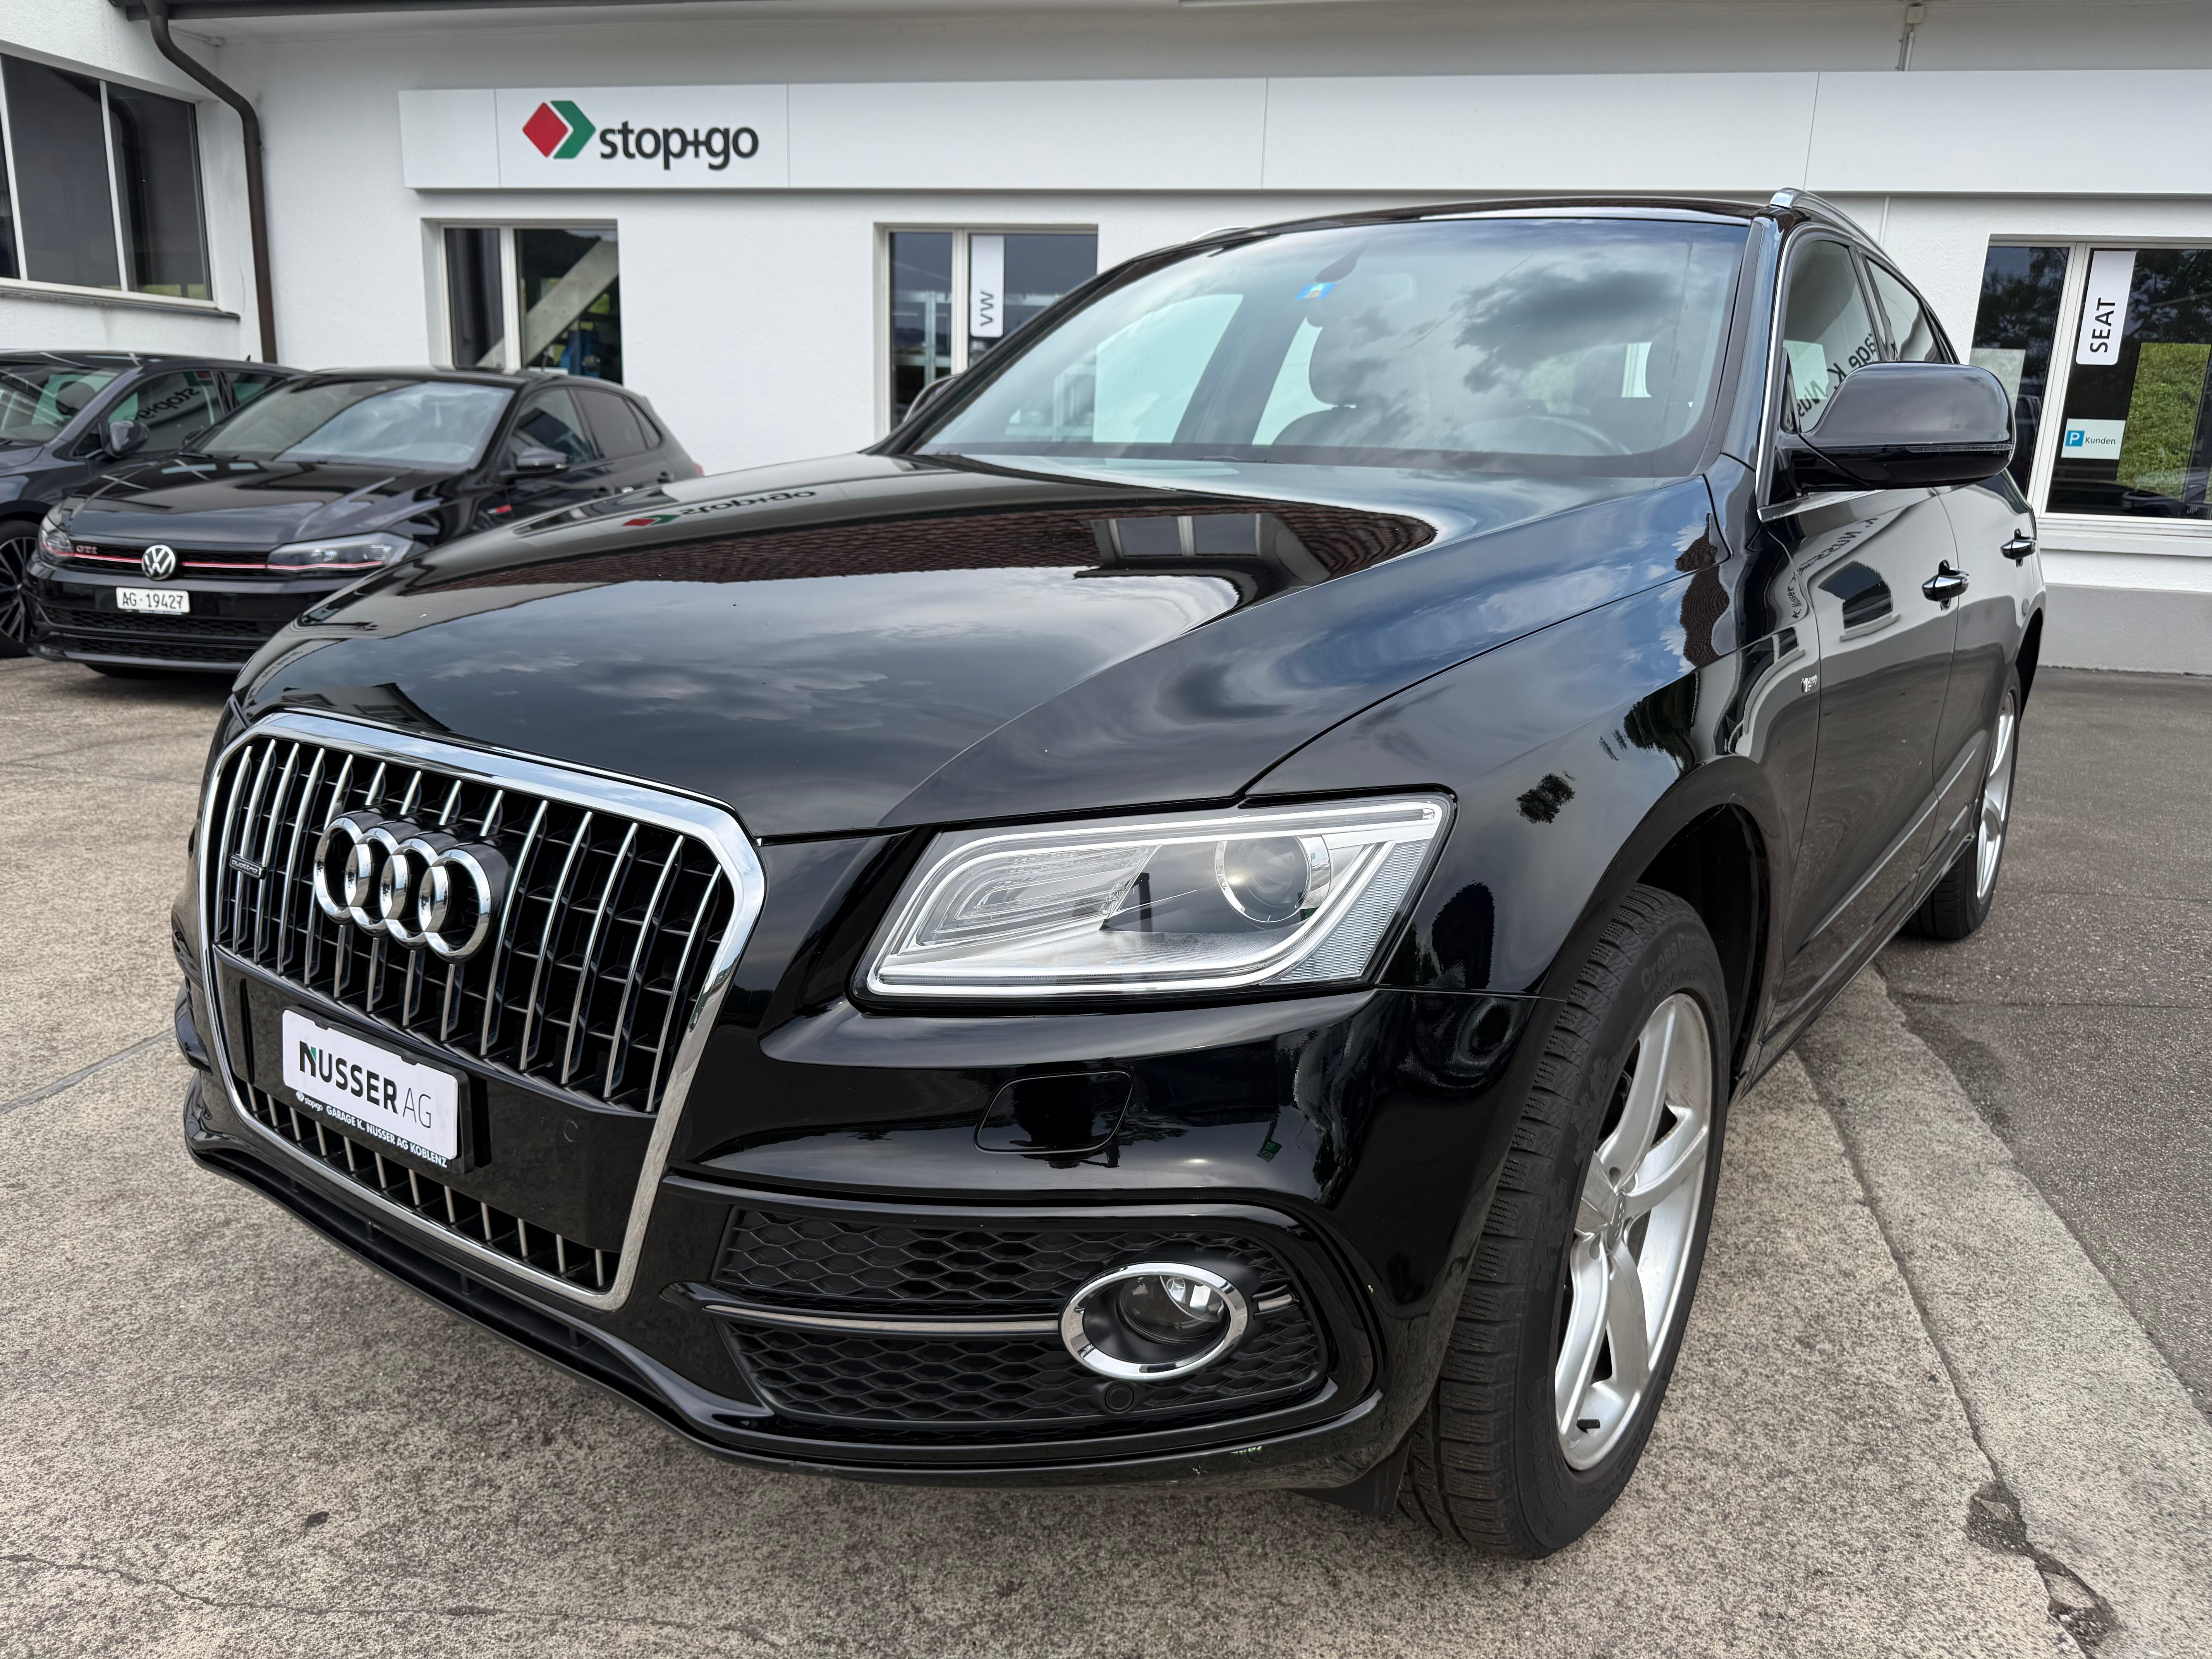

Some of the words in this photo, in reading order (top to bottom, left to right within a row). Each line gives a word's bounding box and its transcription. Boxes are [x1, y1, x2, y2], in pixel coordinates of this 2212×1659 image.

[599, 120, 758, 170] stop+go
[980, 290, 993, 327] VW
[2090, 297, 2115, 353] SEAT
[2069, 432, 2080, 445] P
[2085, 436, 2116, 445] Kunden
[76, 545, 98, 554] GTI
[122, 592, 137, 606] AG
[146, 593, 183, 609] 19427
[231, 859, 258, 874] quattro
[299, 1040, 398, 1115] NUSSER
[402, 1087, 432, 1128] AG
[326, 1105, 356, 1127] GARAGE
[357, 1119, 365, 1131] K.
[366, 1123, 395, 1145] NUSSER
[397, 1137, 409, 1150] AG
[410, 1142, 448, 1168] KOBLENZ
